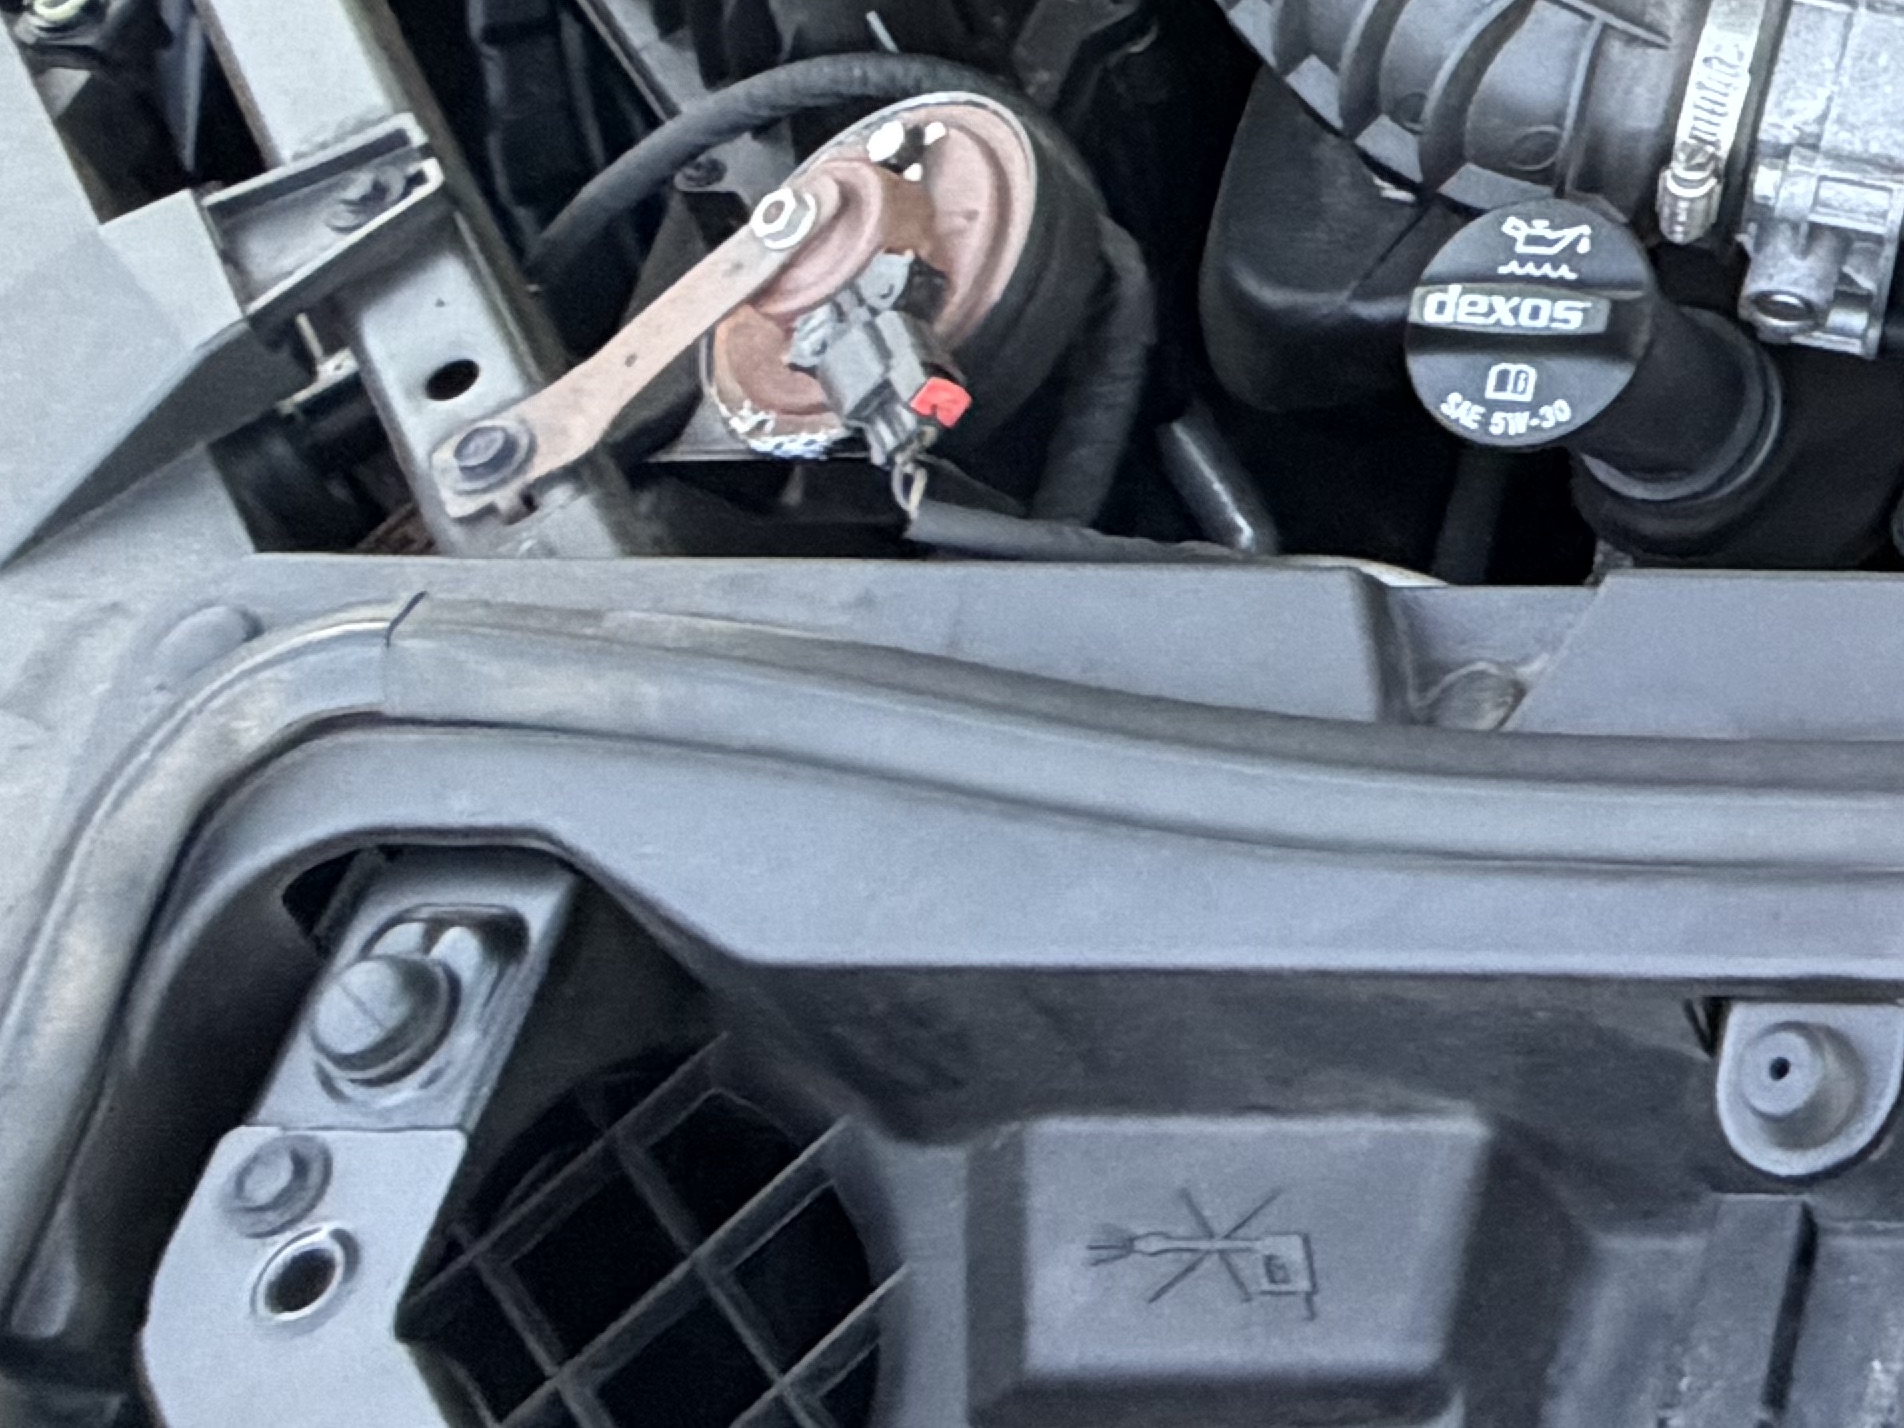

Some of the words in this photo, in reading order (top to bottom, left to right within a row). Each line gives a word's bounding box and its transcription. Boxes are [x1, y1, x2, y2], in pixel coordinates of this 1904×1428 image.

[1423, 284, 1592, 330] dexos
[1440, 392, 1486, 430] SAE
[1488, 398, 1572, 436] 5W-30
